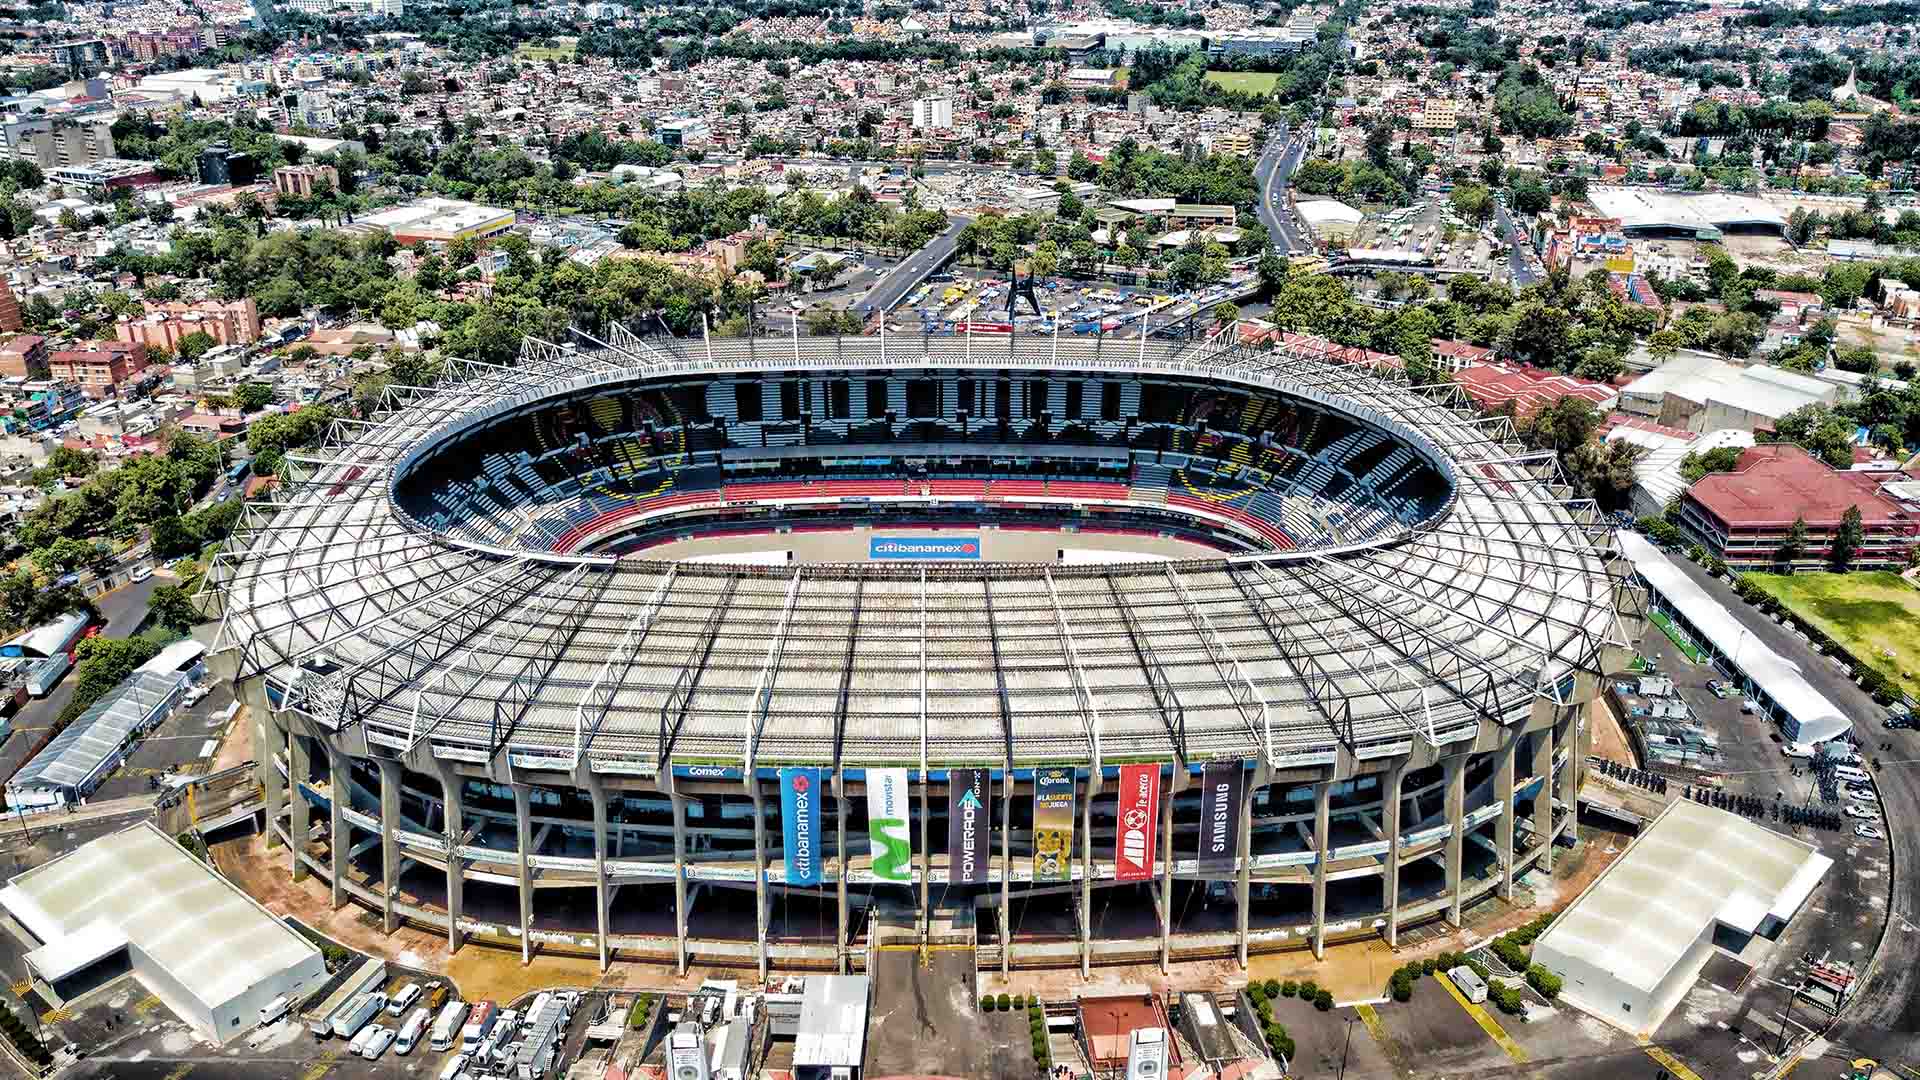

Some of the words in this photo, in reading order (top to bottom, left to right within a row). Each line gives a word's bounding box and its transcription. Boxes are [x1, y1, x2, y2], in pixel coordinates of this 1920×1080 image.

[875, 543, 961, 552] citibanamex
[689, 767, 726, 776] Comex
[1039, 776, 1071, 786] Corona
[884, 775, 894, 816] movistar
[796, 792, 810, 879] citibanamex
[1212, 783, 1230, 853] SAMSUNG
[962, 800, 975, 882] POWERADE
